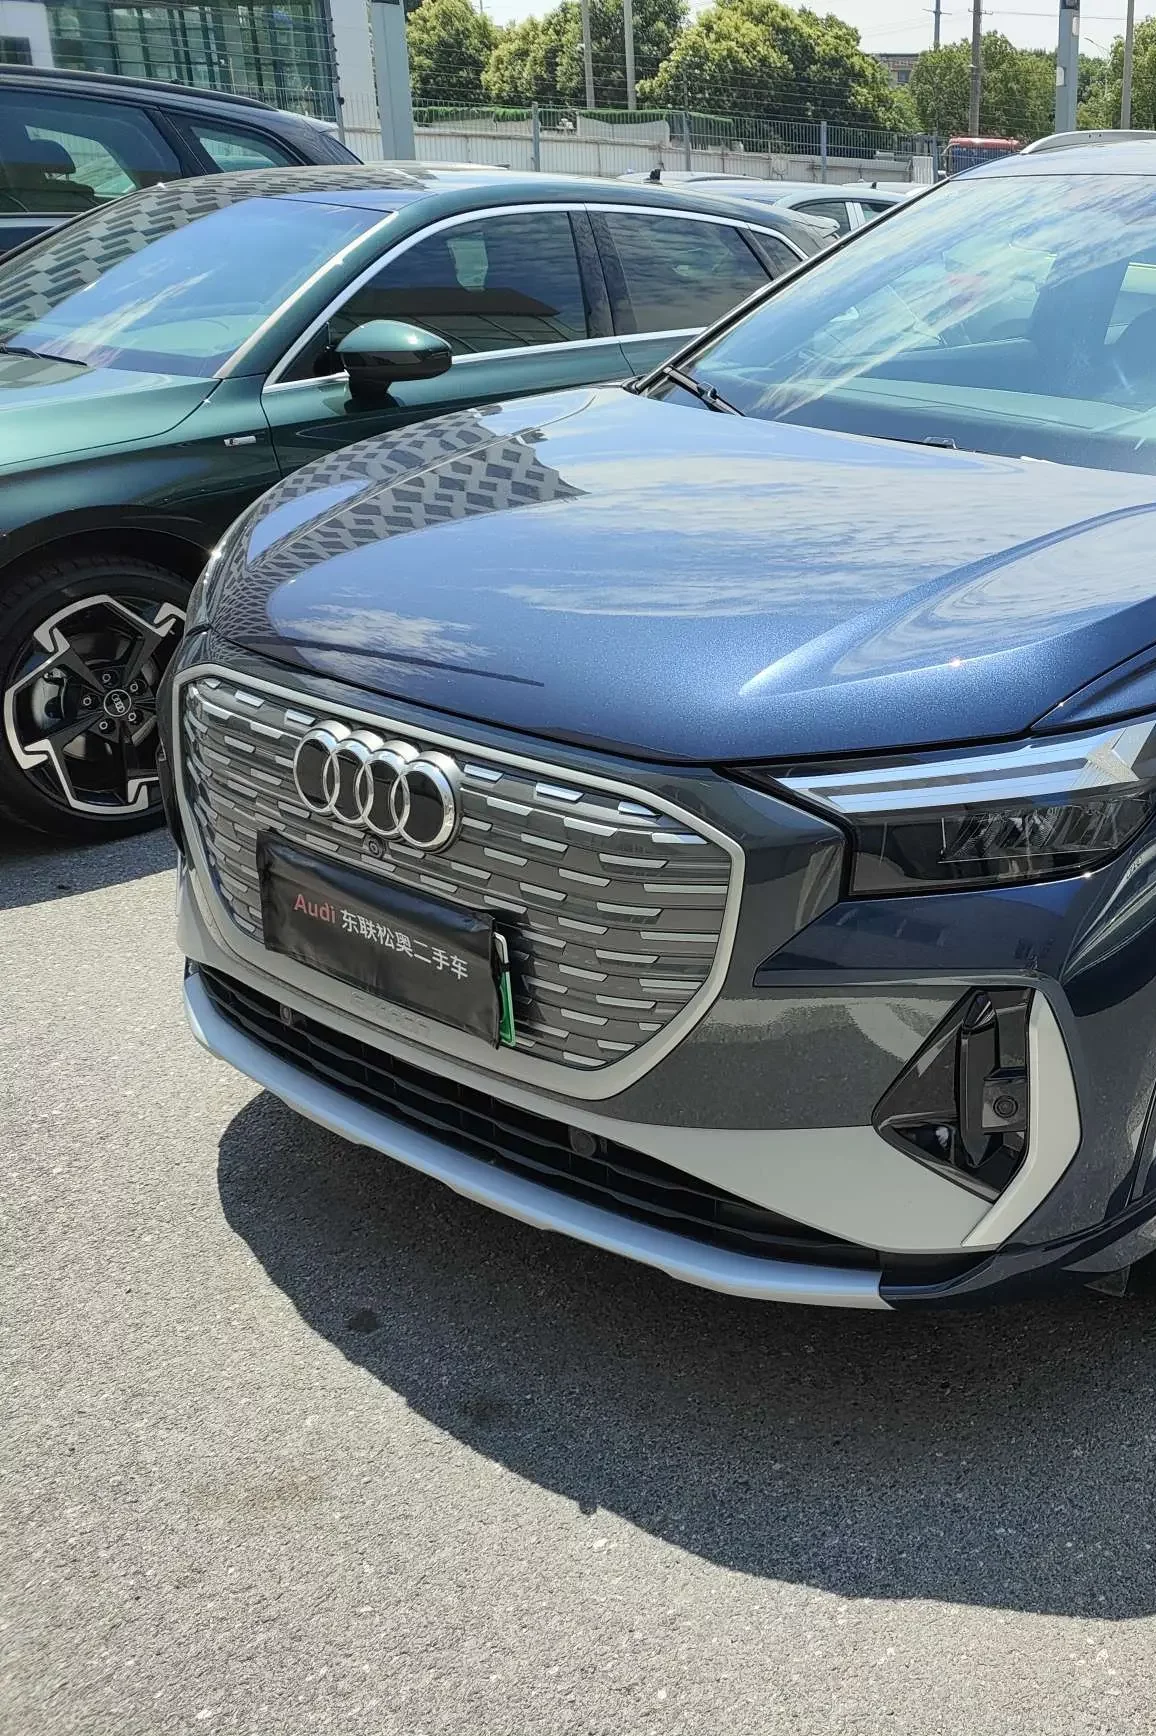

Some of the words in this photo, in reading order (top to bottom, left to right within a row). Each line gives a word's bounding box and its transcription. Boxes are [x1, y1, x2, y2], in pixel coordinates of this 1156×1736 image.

[294, 894, 336, 924] Audi
[340, 909, 468, 980] 东联松奥二手车
